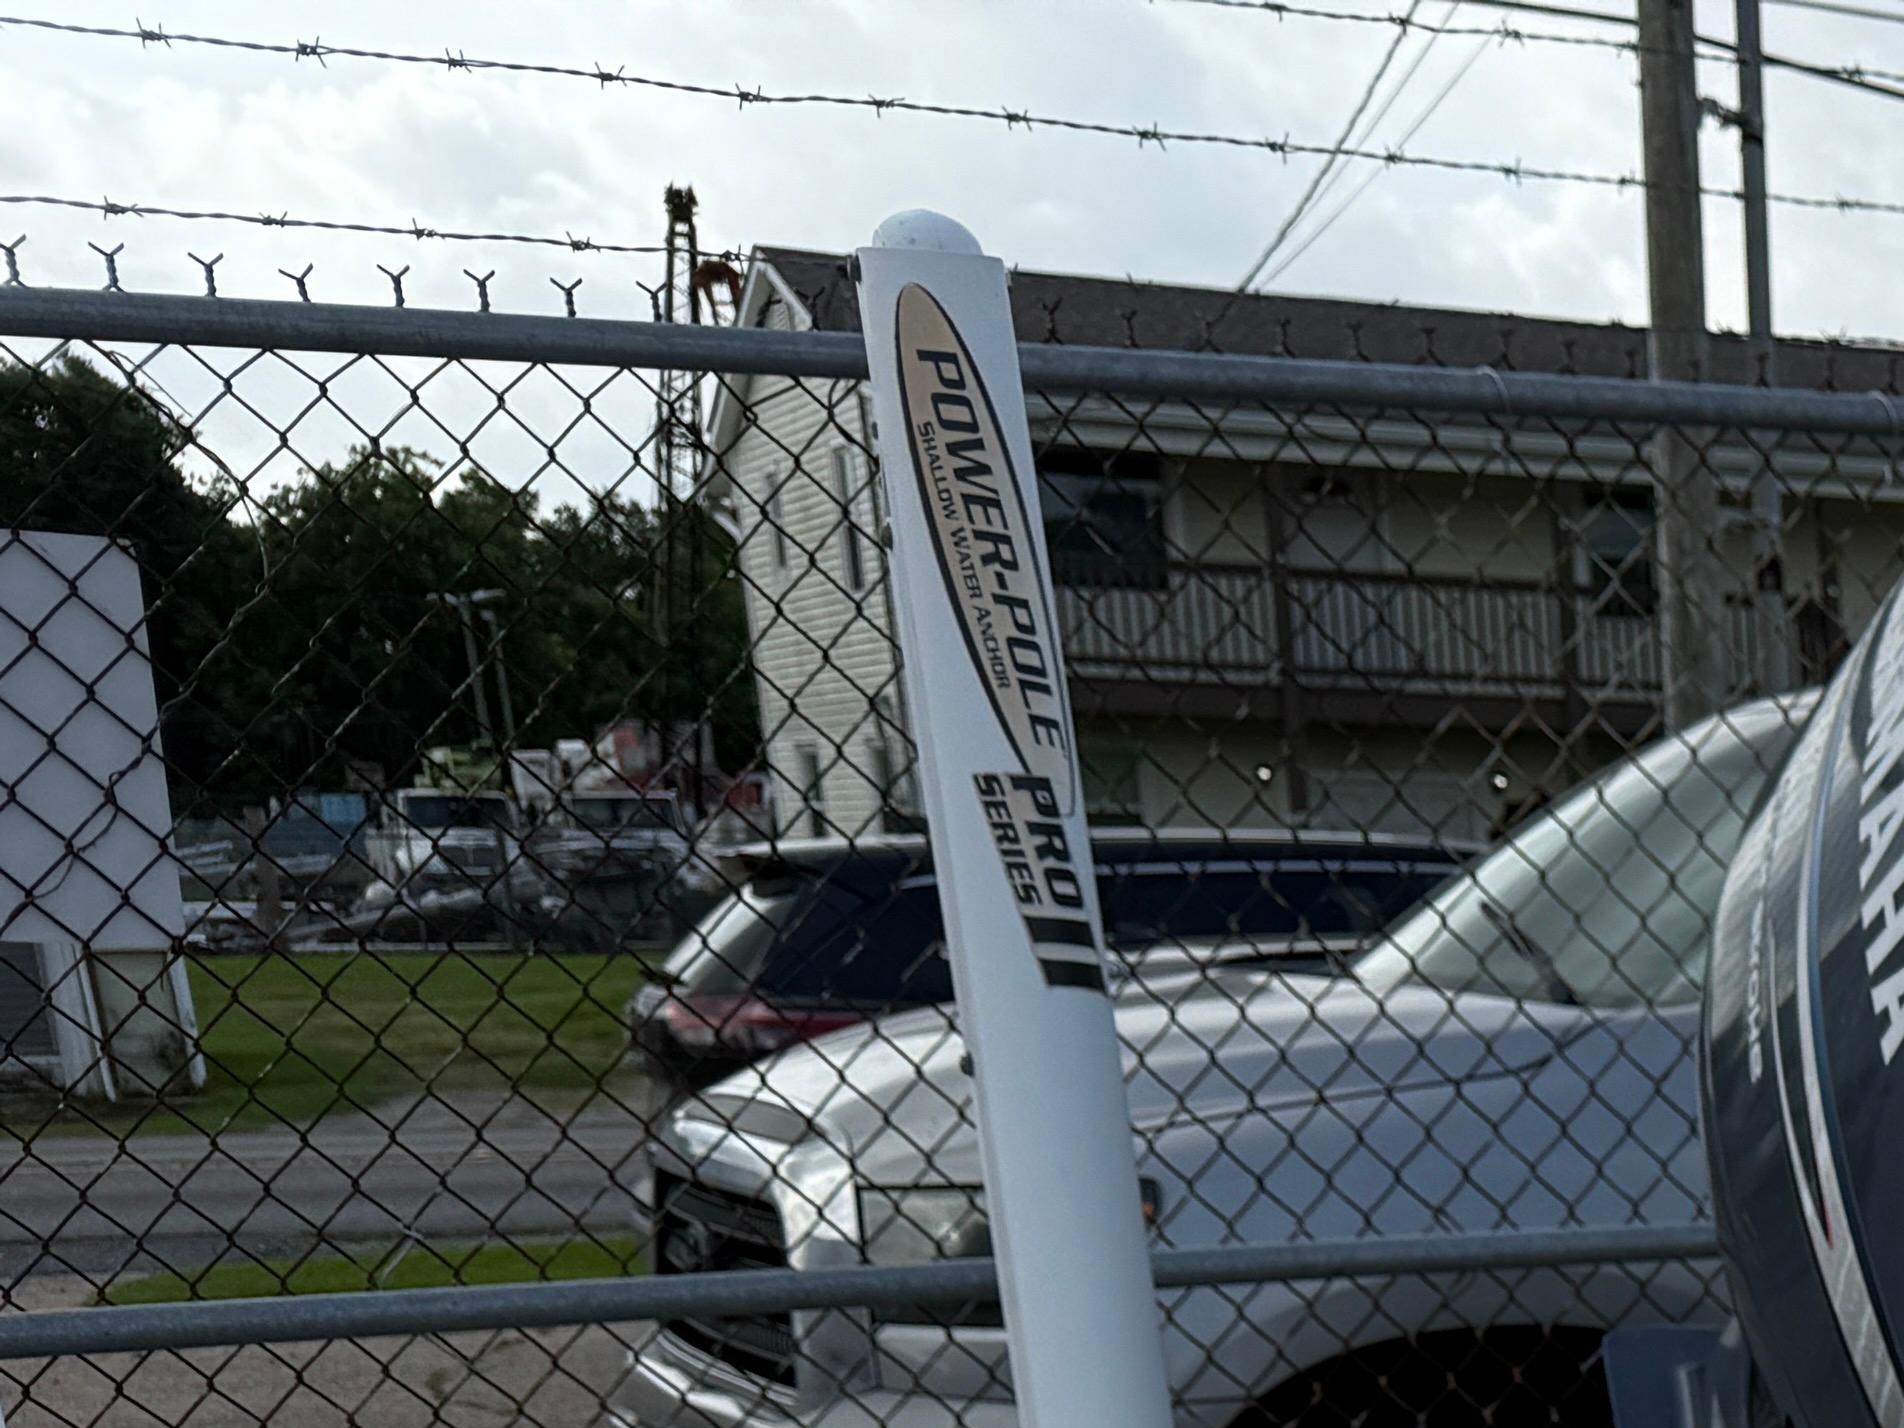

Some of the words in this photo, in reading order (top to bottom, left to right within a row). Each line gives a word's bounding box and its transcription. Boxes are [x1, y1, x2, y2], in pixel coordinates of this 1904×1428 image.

[915, 347, 1064, 751] POWER-POLE
[916, 421, 959, 522] SHALLOW
[950, 525, 985, 602] WATER
[974, 605, 1012, 690] ANCHOR
[973, 772, 1043, 906] SERIES
[1010, 775, 1083, 908] PRO
